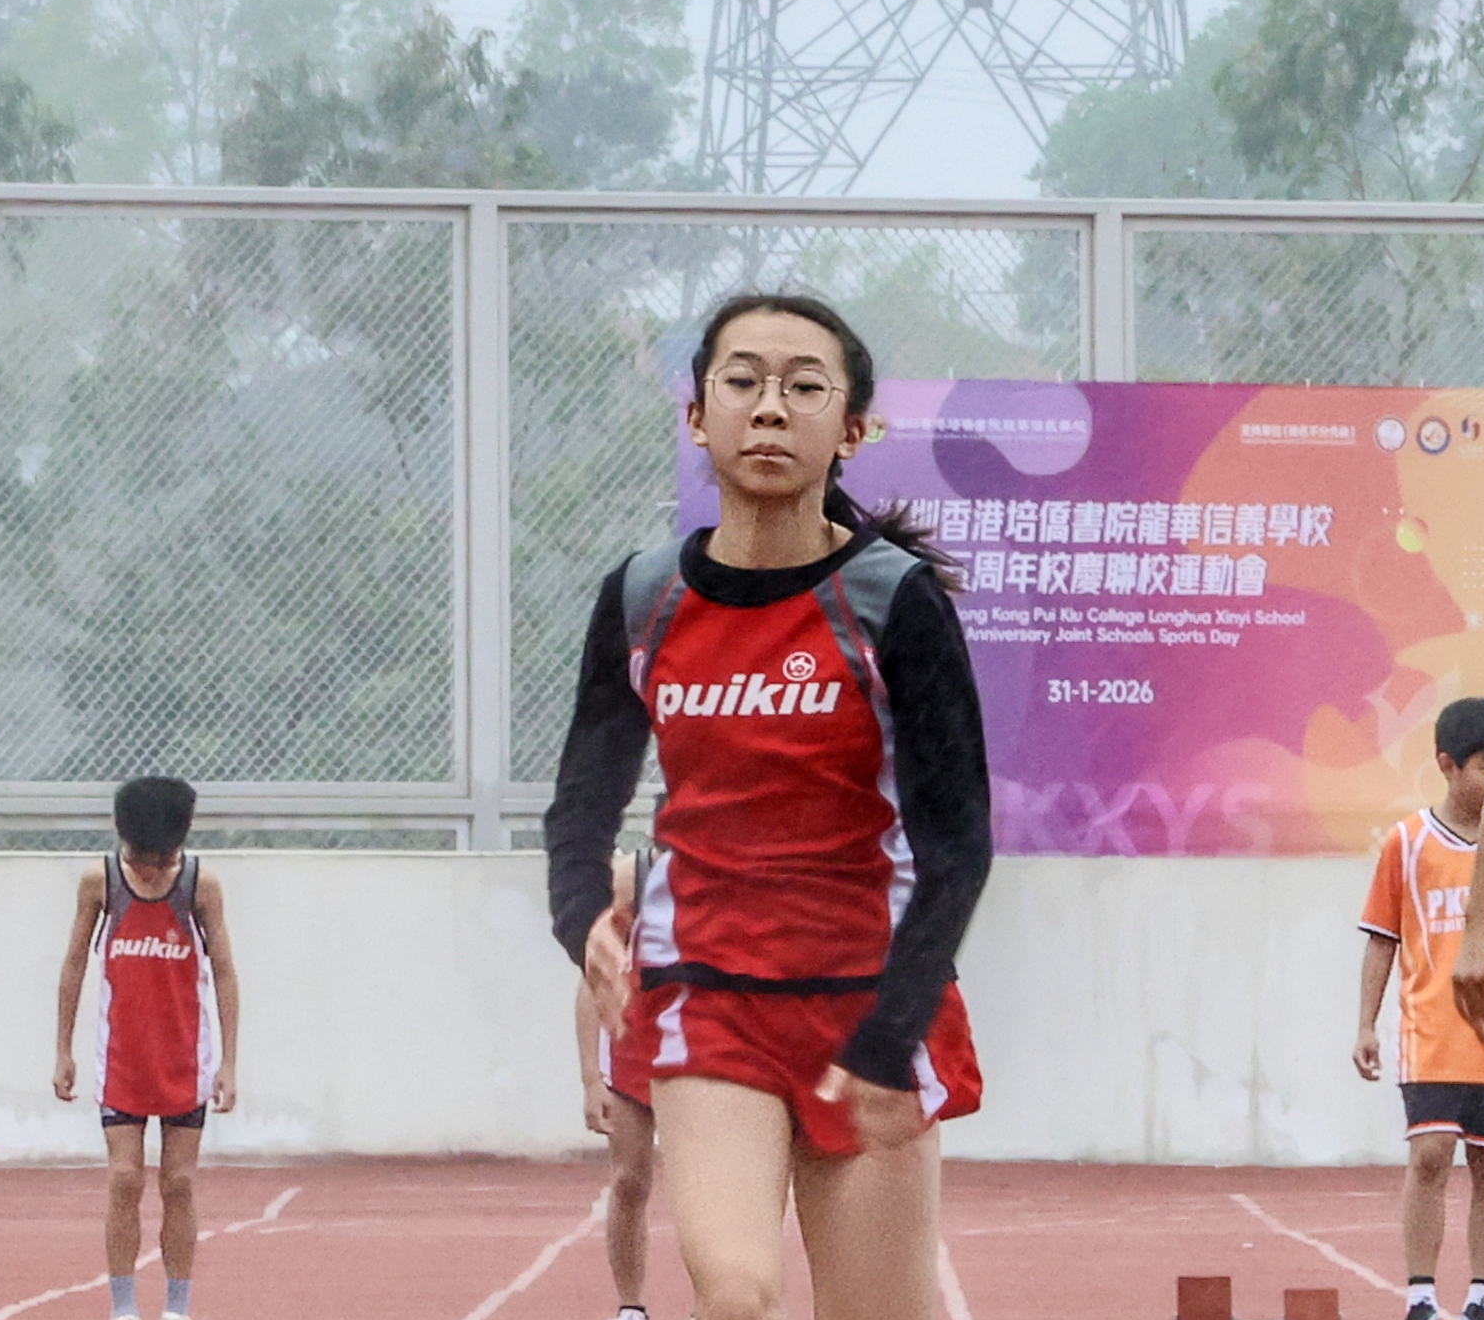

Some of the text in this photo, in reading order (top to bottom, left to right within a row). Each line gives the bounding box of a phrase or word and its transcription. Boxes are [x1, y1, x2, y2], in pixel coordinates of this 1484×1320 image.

[878, 498, 1334, 547] 圳香港培僑書院龍華信義學校
[957, 606, 1306, 628] ong Kong Pui Kiu College Longhua Xinyi School
[966, 626, 1241, 648] Anniversary Joint Schools Sports Day
[656, 673, 842, 724] puikiu
[1047, 679, 1155, 704] 31-1-2026
[109, 935, 192, 960] puikiu
